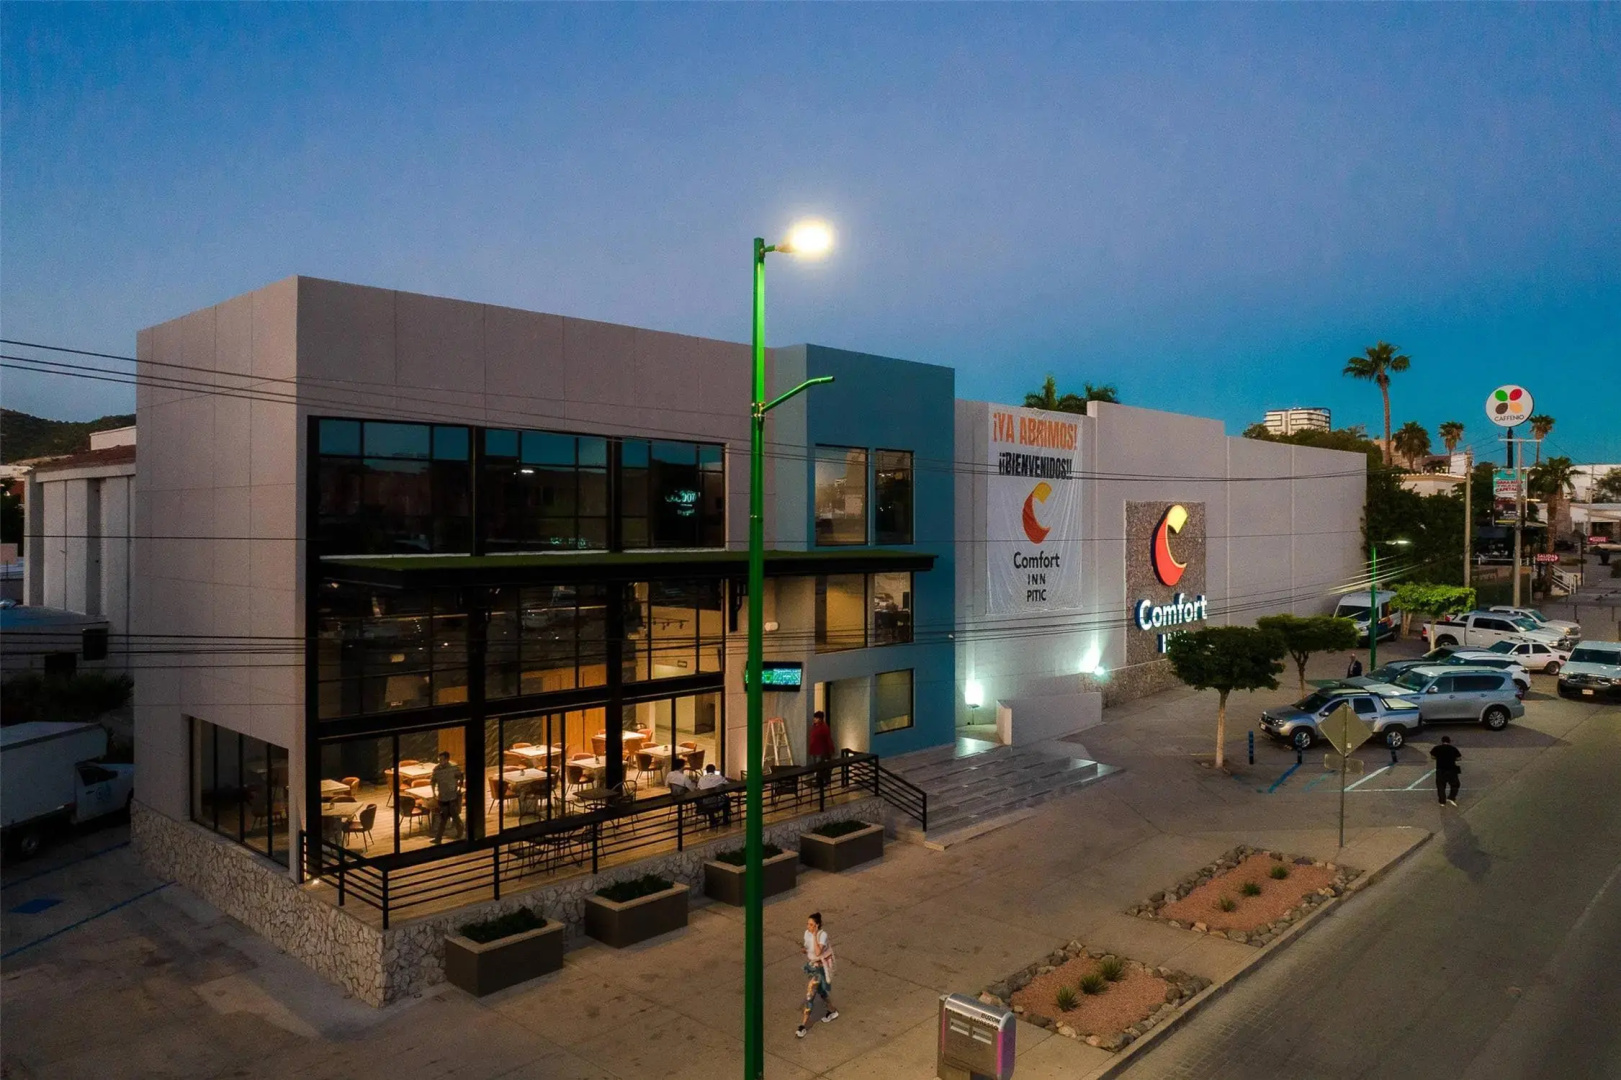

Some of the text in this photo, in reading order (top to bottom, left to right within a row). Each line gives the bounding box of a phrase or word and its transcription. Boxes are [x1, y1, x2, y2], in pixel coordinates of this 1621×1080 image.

[1494, 414, 1525, 422] CAFFENIO
[1013, 550, 1060, 569] Comfort
[1027, 573, 1046, 585] INN
[1026, 589, 1047, 602] PITIC
[1137, 592, 1208, 631] Comfort
